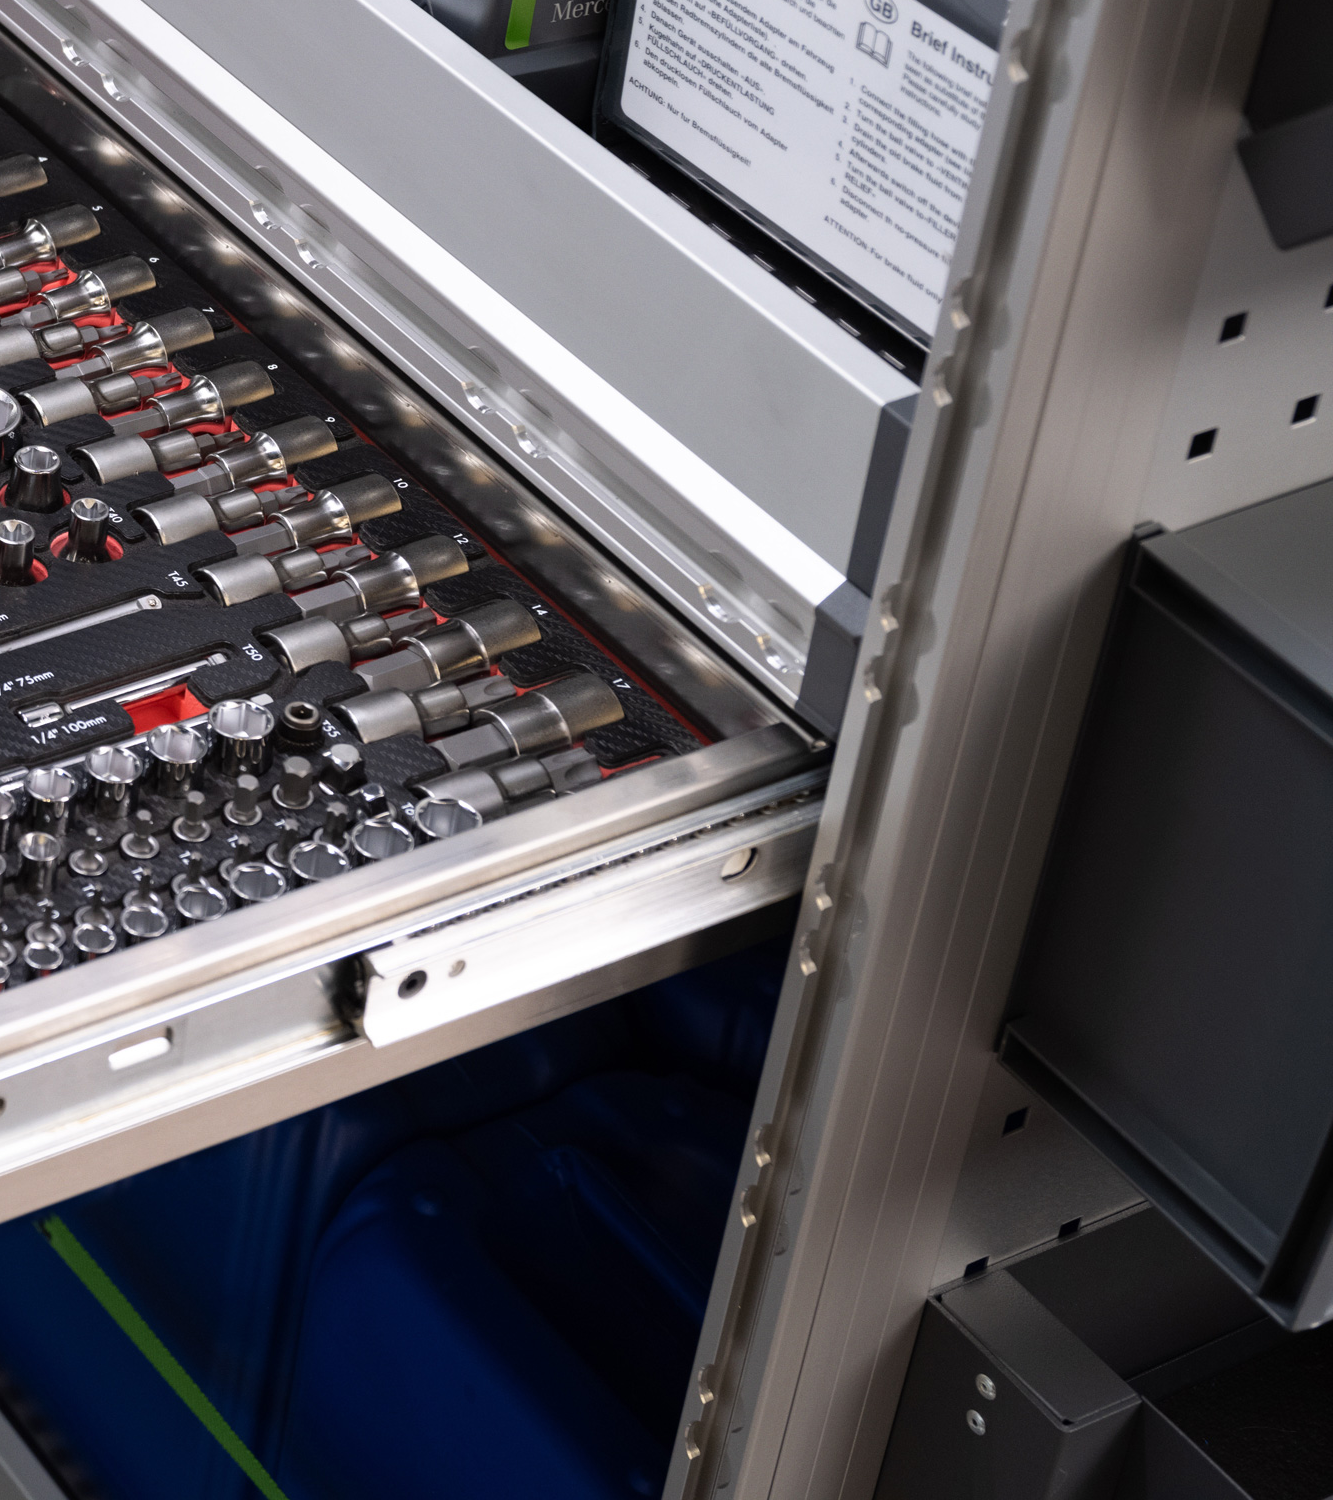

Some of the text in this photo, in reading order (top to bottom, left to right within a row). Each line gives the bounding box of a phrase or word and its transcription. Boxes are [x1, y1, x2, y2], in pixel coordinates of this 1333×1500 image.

[910, 20, 948, 55] Brief
[267, 363, 279, 371] 8
[393, 477, 409, 489] 10
[453, 533, 469, 545] 12
[167, 570, 189, 587] T45
[531, 604, 548, 616] 14
[241, 643, 264, 661] T50
[15, 671, 55, 687] 75mm
[612, 677, 631, 689] 17
[30, 714, 108, 745] 1/4" 100mm
